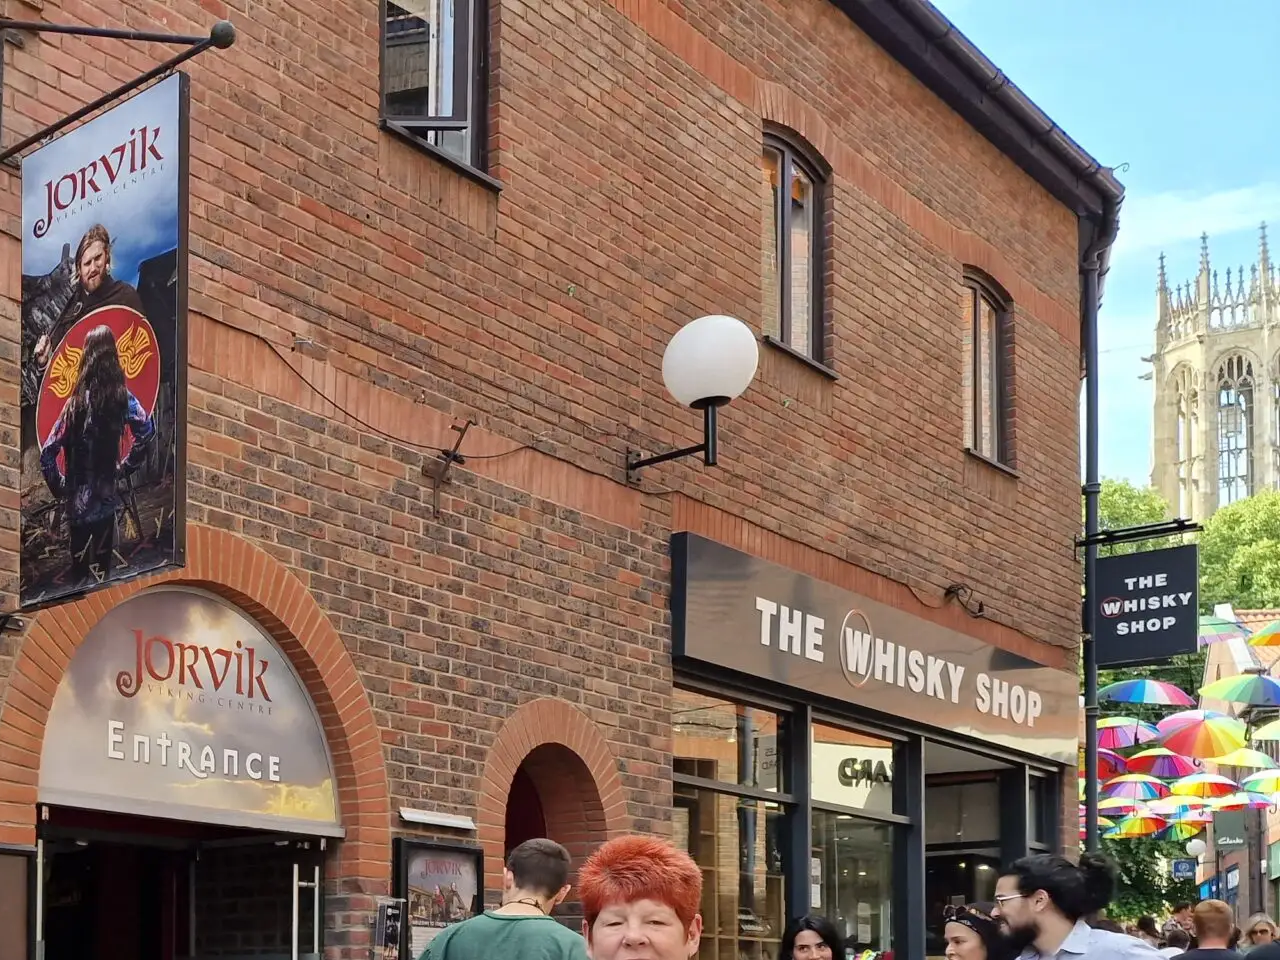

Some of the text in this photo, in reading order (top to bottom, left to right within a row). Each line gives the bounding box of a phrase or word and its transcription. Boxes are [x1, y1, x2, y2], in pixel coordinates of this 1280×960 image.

[1124, 573, 1168, 591] THE
[1103, 592, 1193, 615] WHISKY
[1116, 616, 1177, 636] SHOP
[755, 596, 1043, 728] THE WHISKY SHOP
[147, 684, 273, 716] VIKING CENTRE
